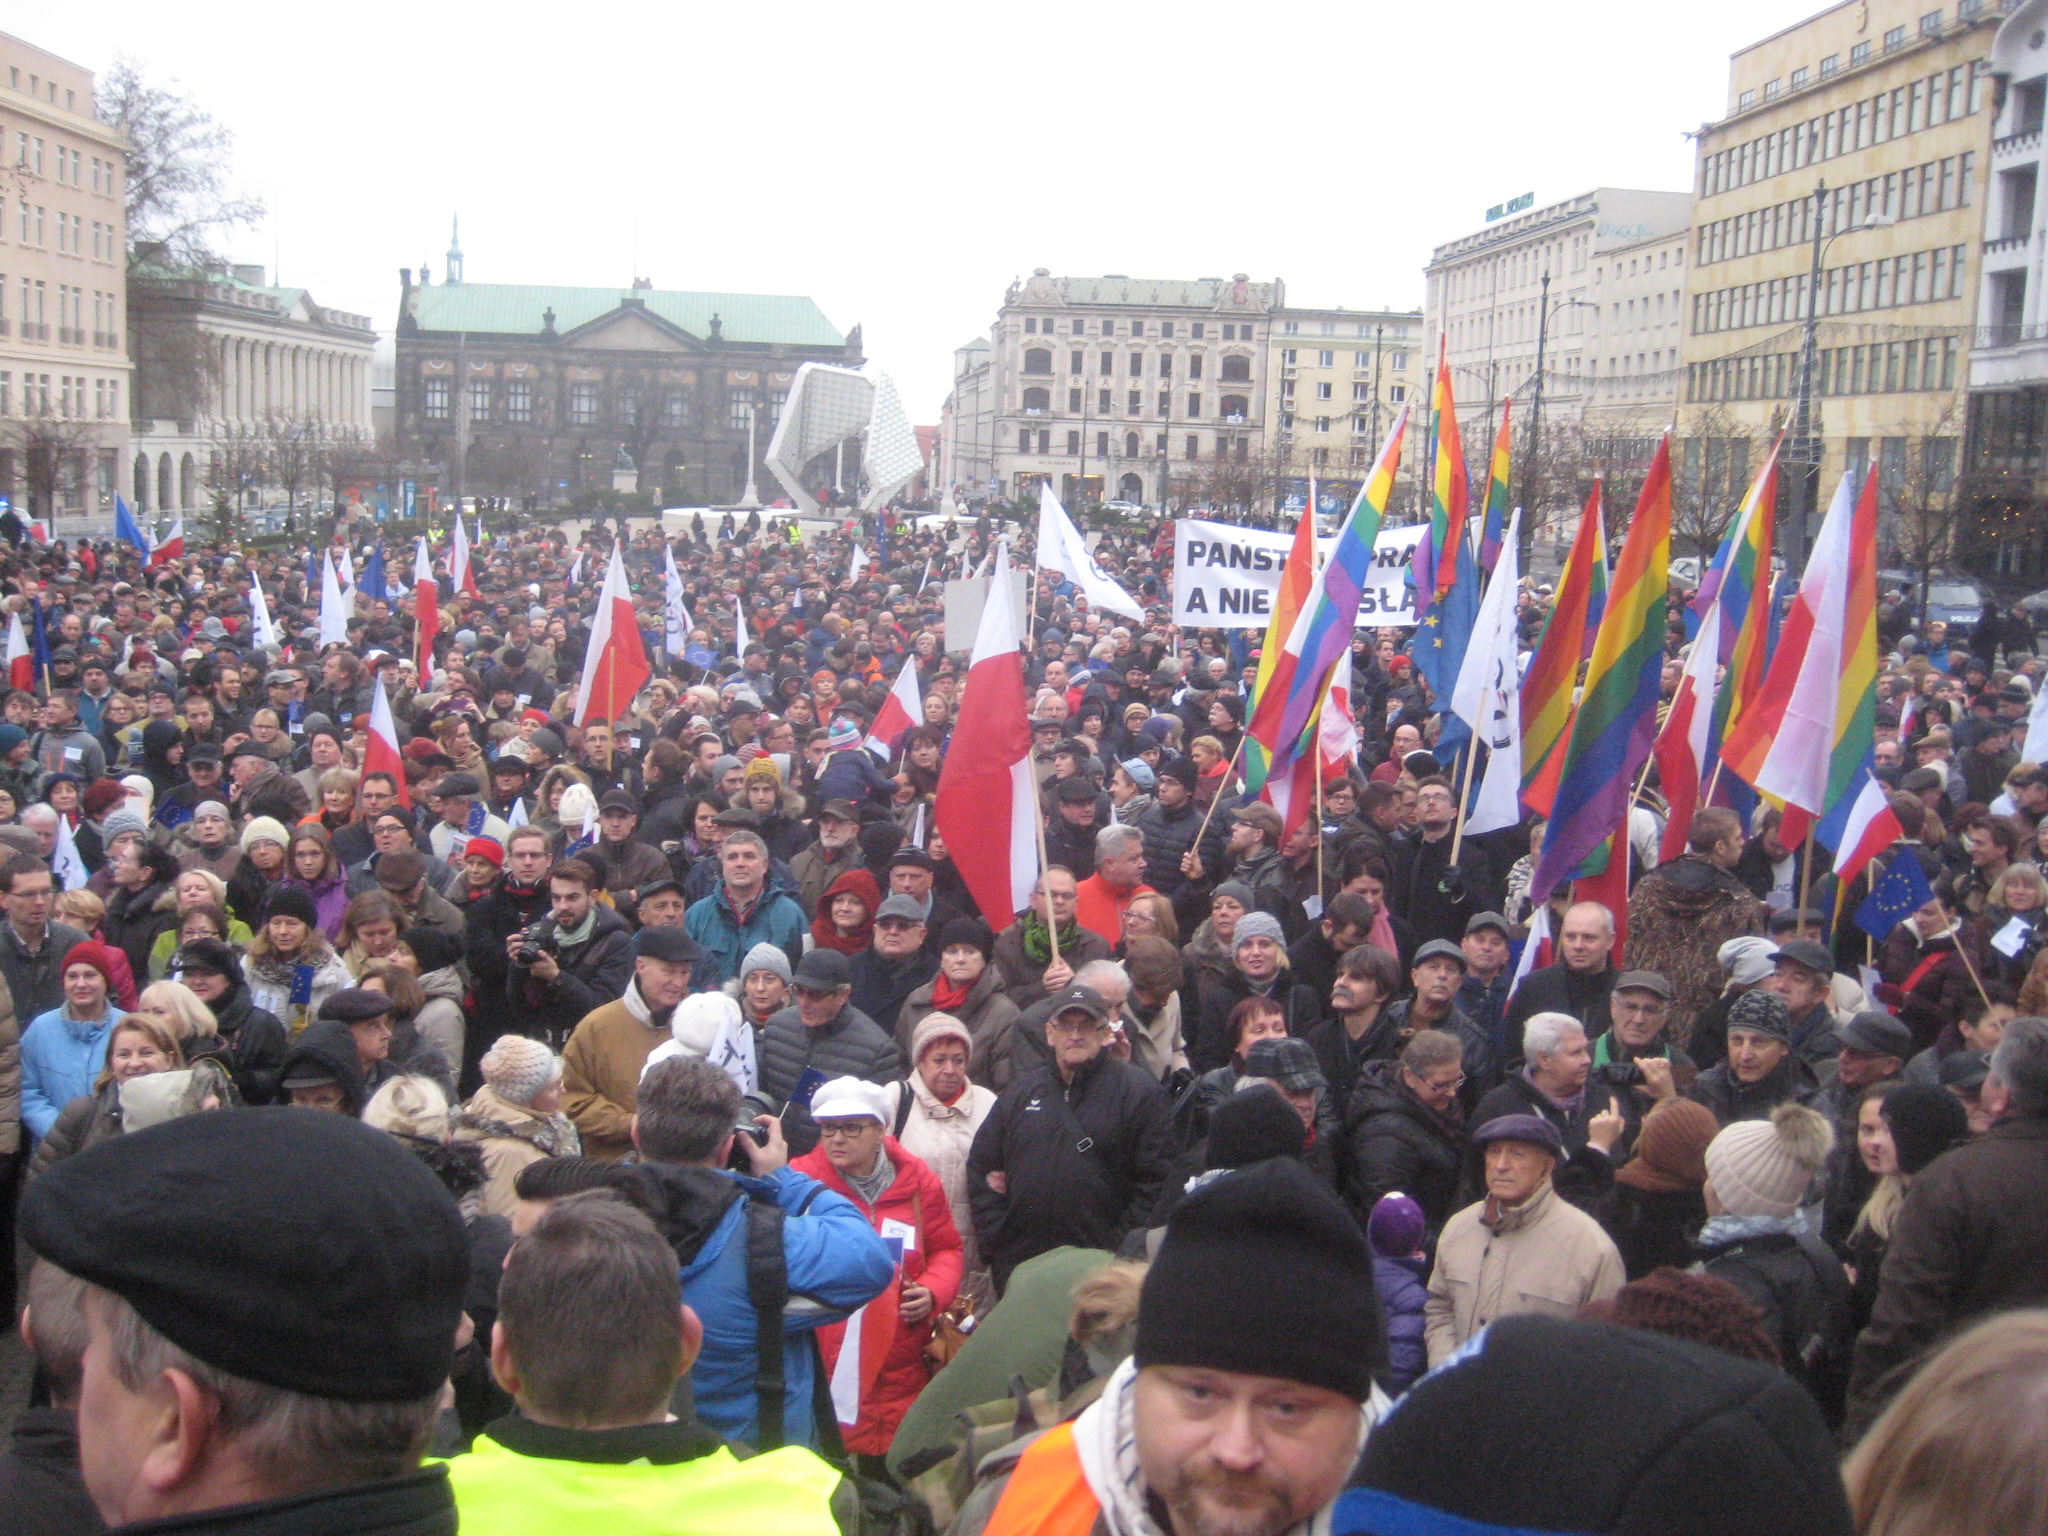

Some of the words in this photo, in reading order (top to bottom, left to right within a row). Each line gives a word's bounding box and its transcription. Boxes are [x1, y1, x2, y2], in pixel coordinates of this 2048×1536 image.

[1187, 538, 1291, 572] PAŃST
[1371, 543, 1417, 568] RA
[1185, 586, 1208, 614] A
[1219, 587, 1270, 614] NIE
[1359, 586, 1418, 614] SŁA
